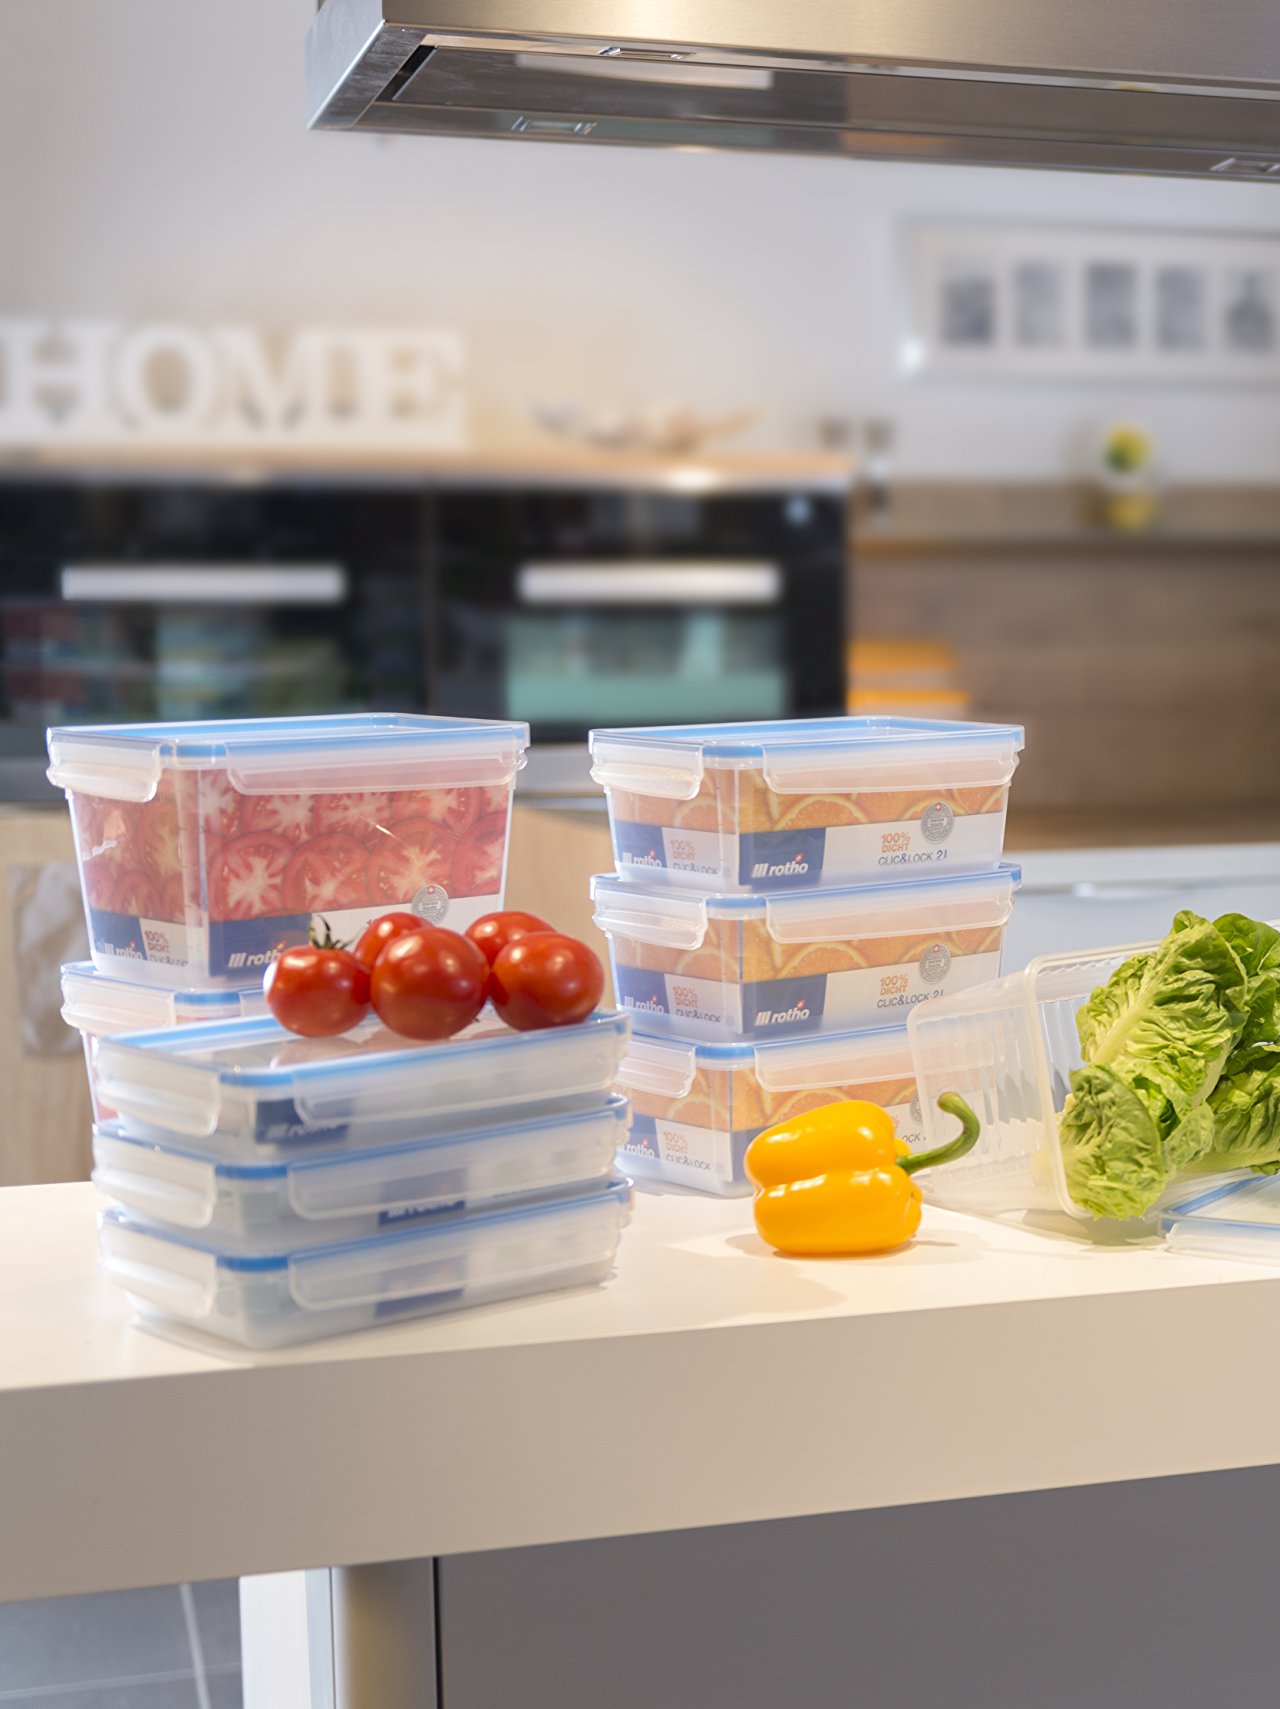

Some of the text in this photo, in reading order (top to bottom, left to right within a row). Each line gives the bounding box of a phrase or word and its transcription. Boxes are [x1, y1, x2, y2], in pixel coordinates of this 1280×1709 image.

[0, 319, 470, 451] HOME
[881, 832, 910, 844] 100%
[881, 843, 909, 853] DICHT
[878, 853, 933, 865] CLIC&LOCK
[769, 860, 809, 876] rotho
[247, 949, 282, 967] roth
[880, 974, 909, 987] 100%
[880, 985, 907, 996] DICHT
[877, 993, 930, 1008] CLIC&LOCK
[772, 1006, 810, 1023] rotho
[626, 1143, 655, 1158] rotho
